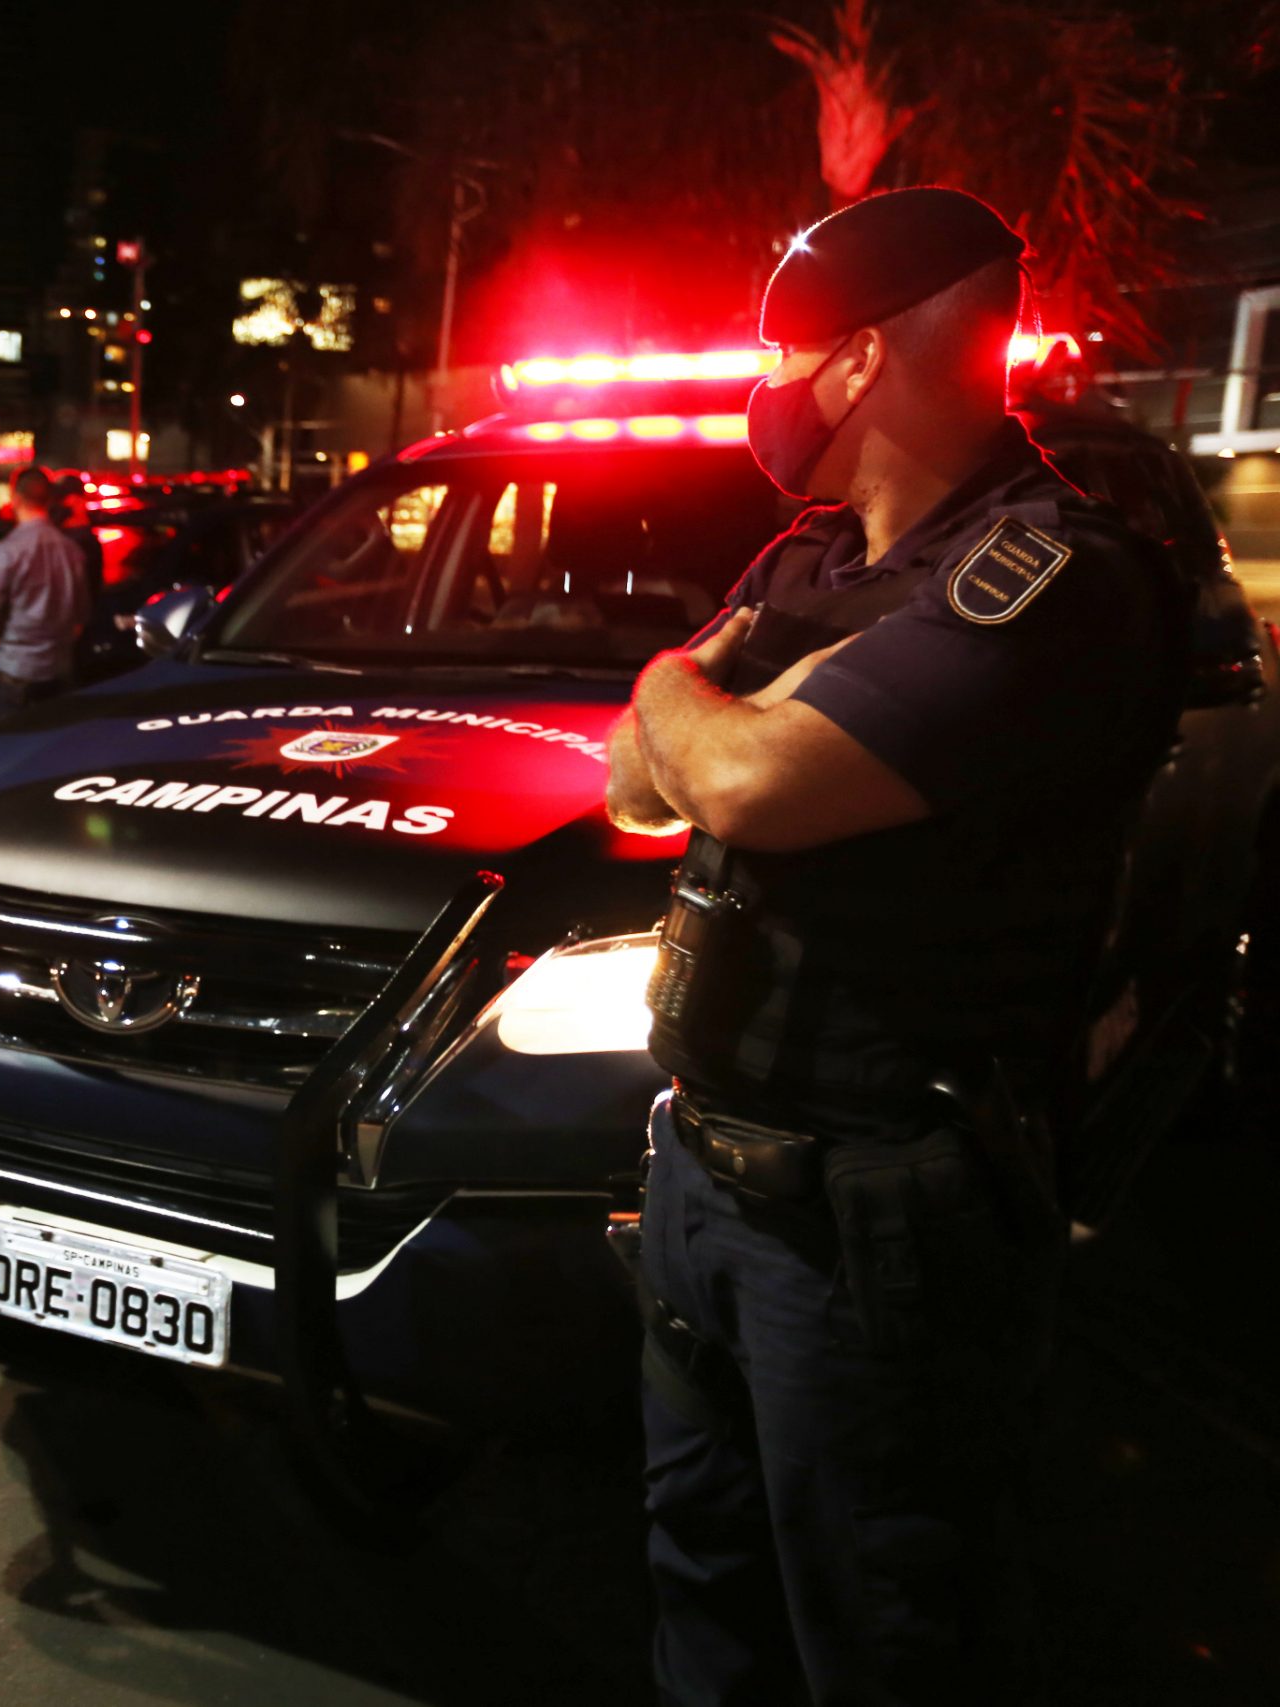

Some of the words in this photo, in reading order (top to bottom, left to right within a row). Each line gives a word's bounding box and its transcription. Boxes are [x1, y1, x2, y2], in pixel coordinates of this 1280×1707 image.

[1001, 540, 1040, 568] GUARDA
[136, 706, 354, 731] GUARDA
[53, 776, 455, 834] CAMPINAS
[63, 1249, 140, 1278] SP-CAMPINAS
